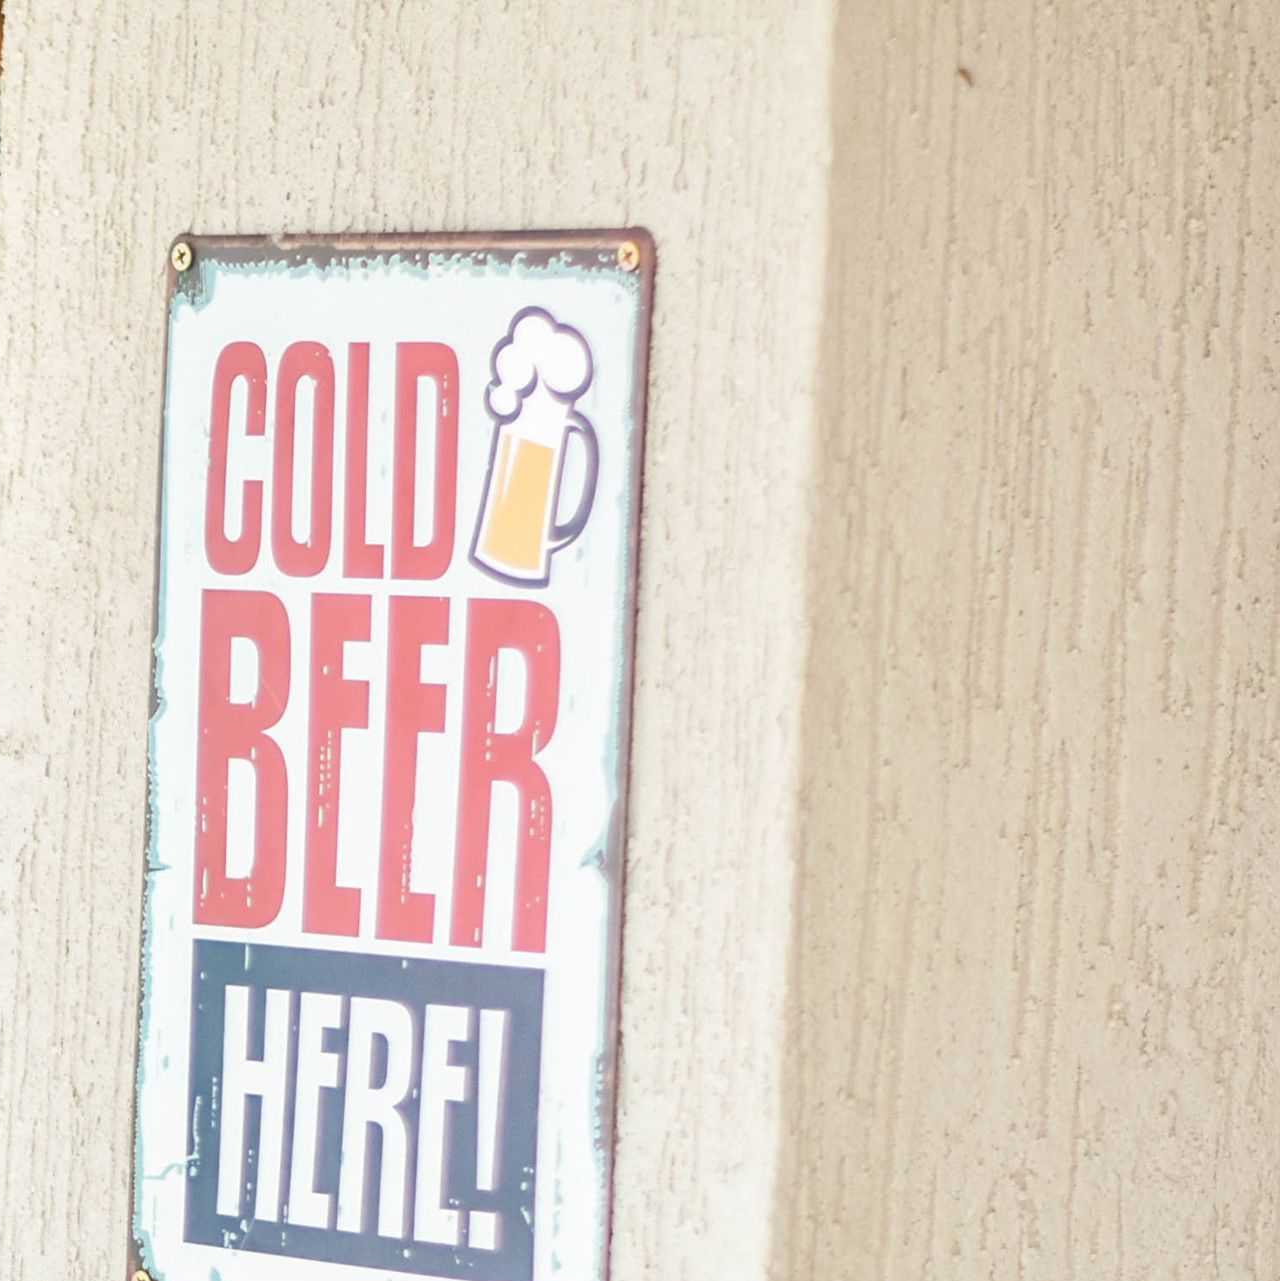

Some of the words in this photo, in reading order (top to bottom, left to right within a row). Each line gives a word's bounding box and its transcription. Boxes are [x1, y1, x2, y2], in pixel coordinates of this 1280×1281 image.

[204, 340, 460, 580] COLD
[192, 588, 561, 954] BEER
[216, 984, 506, 1251] HERE!
